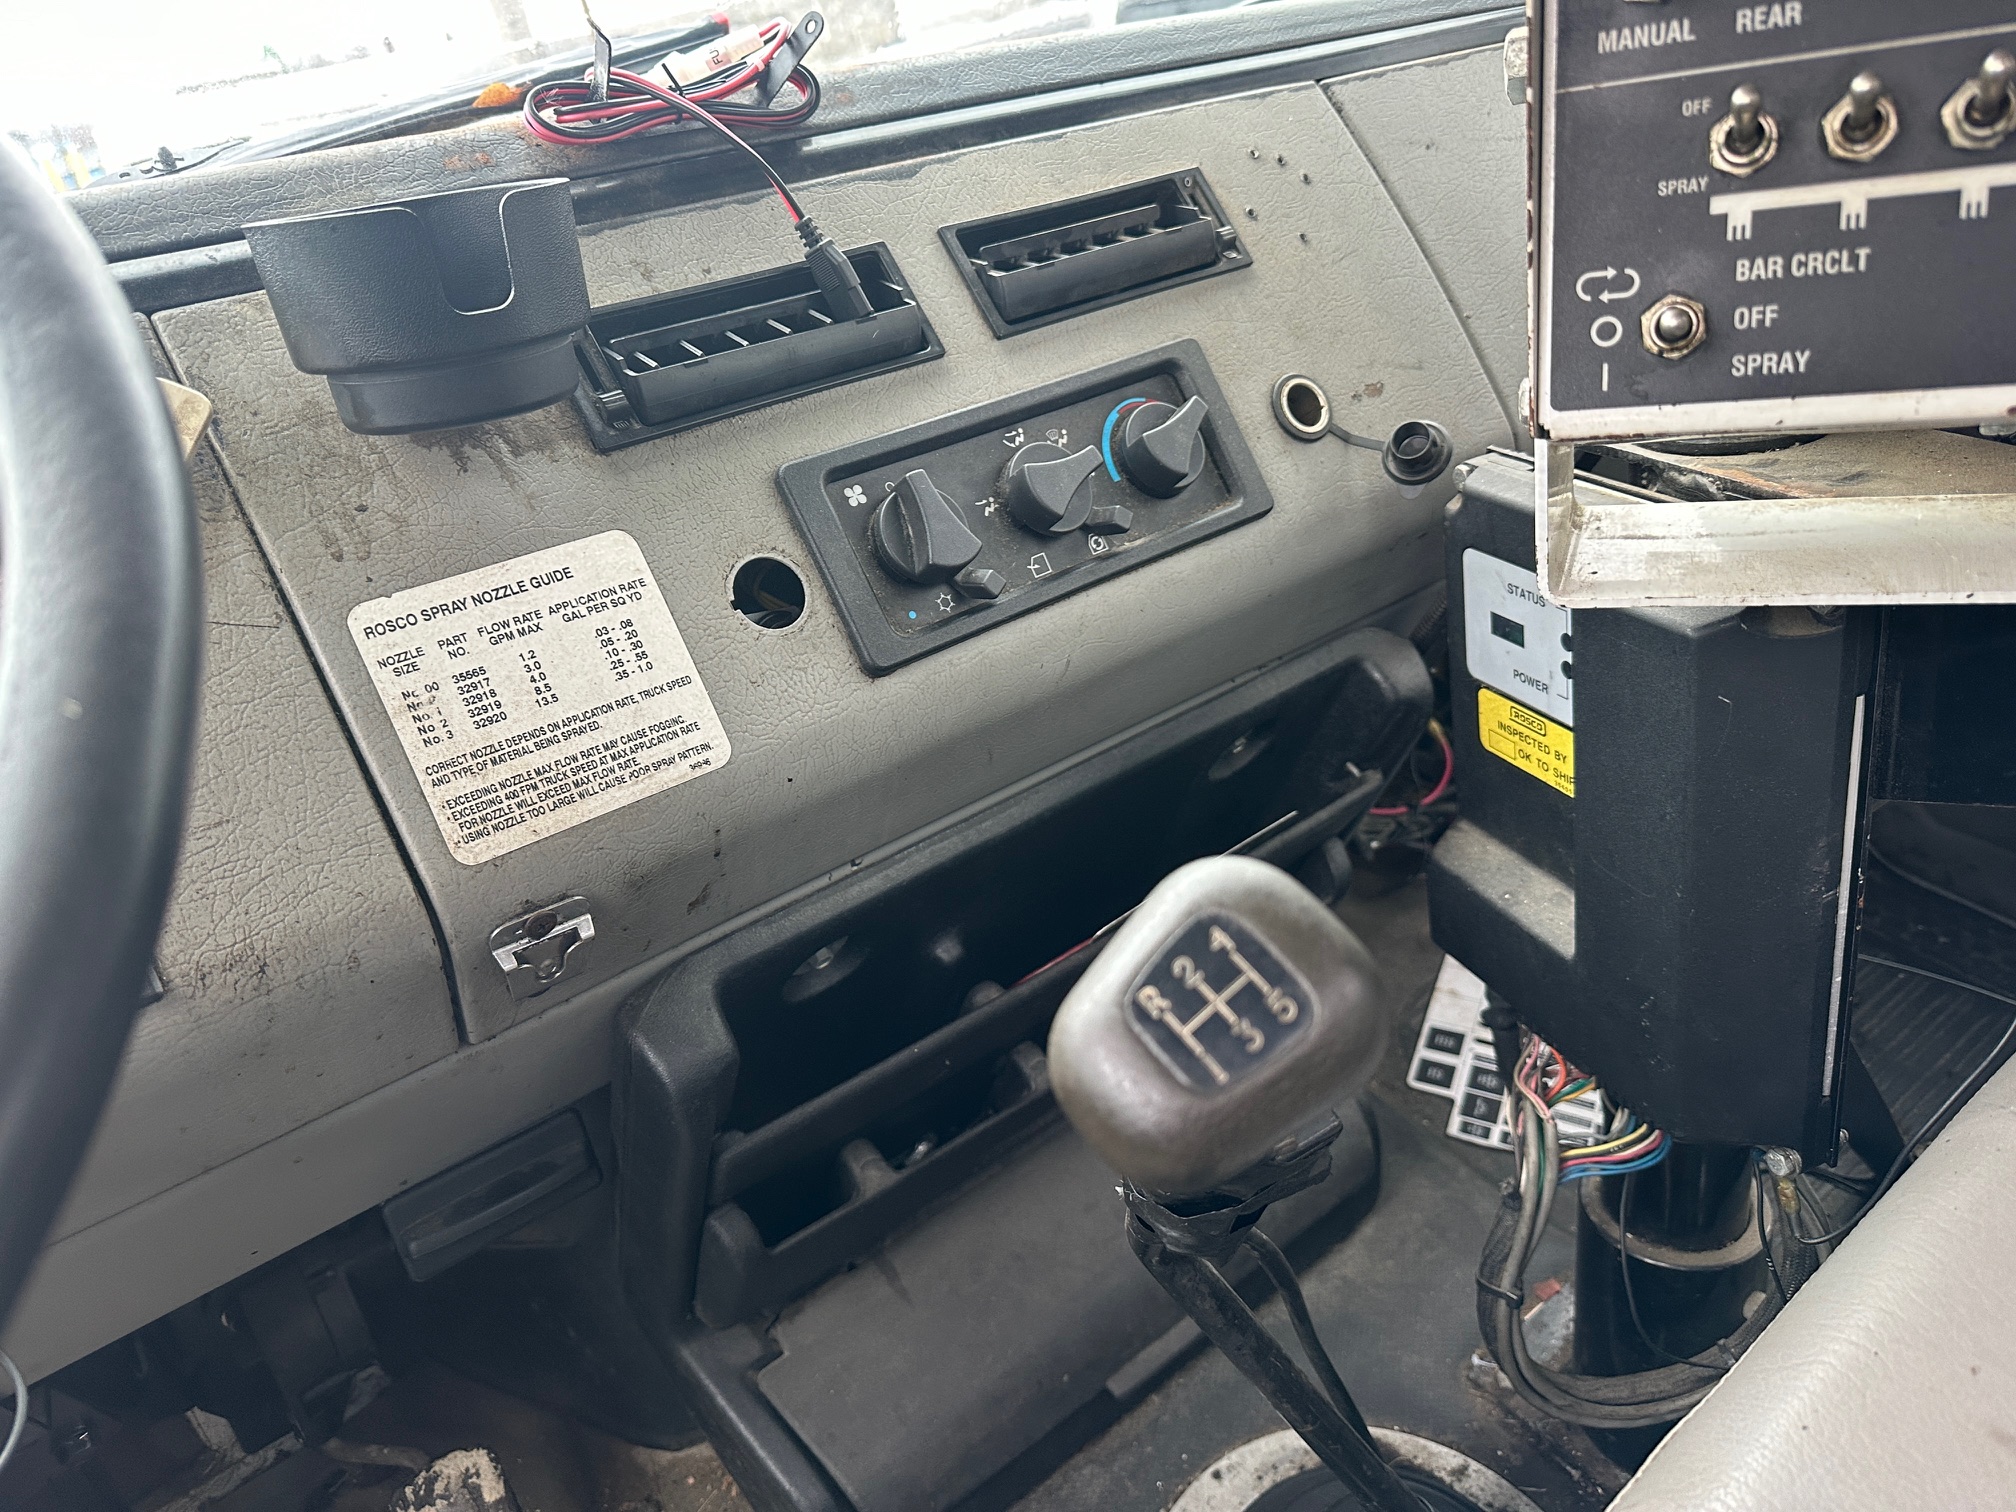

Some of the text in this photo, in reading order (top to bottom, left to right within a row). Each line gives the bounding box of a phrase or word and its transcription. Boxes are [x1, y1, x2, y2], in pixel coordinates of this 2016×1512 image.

[1598, 18, 1696, 54] MANUAL
[1736, 1, 1802, 34] REAR
[1682, 96, 1713, 116] OFF
[1658, 174, 1709, 196] SPRAY
[1736, 246, 1872, 282] BAR CRCLT
[1734, 304, 1779, 330] OFF
[1731, 348, 1811, 377] SPRAY
[363, 567, 574, 640] ROSCO SPRAY NOZZLE GUIDE
[377, 578, 647, 670] NOZZLE PART FLOW RATE APPLICATION RATE
[1507, 582, 1546, 608] STATUS
[392, 592, 642, 677] SIZE NO. GPM MAX GAL PER SQ YD
[424, 682, 440, 693] 00
[452, 666, 487, 684] 35565
[519, 650, 537, 662] 1.2
[595, 626, 610, 638] .03
[619, 619, 634, 630] .08
[457, 677, 490, 695] 32917
[524, 661, 541, 673] 3.0
[600, 637, 615, 649] .05
[625, 630, 638, 641] .20
[422, 736, 444, 748] No.
[446, 730, 454, 739] 3
[473, 711, 507, 730] 32920
[535, 694, 559, 708] 13.5
[615, 669, 630, 682] .35
[638, 662, 653, 673] 1.0
[440, 719, 449, 728] 2
[468, 700, 502, 718] 32919
[534, 683, 552, 696] 8.5
[610, 659, 625, 671] .25
[635, 651, 648, 663] .55
[462, 689, 497, 707] 32918
[530, 672, 547, 684] 4.0
[605, 648, 619, 660] .10
[630, 640, 643, 652] .30
[1513, 669, 1549, 694] POWER
[426, 676, 692, 776] CORRECT NOZZLE DEPENDS ON APPLICATION RATE, TRUCK SPEED
[1498, 720, 1567, 763] INSPECTED BY
[1514, 710, 1542, 731] ROSCO
[432, 721, 603, 788] AND TYPE OF MATERIAL BEING SPRAYED.
[446, 715, 685, 810] EXCEEDING NOZZLE MAX FLOW RATE MAY CAUSE FOGGING.
[451, 722, 701, 822] EXCEEDING 400 FPM TRUCK SPEED AT MAX APPLICATION RATE
[1518, 748, 1532, 763] OK
[1536, 758, 1549, 772] TO
[458, 757, 641, 832] FOR NOZZLE WILL EXCEED MAX FLOW RATE.
[461, 827, 491, 844] USING
[491, 813, 527, 834] NOZZLE
[526, 806, 546, 819] TOO
[546, 793, 578, 812] LARGE
[576, 786, 599, 800] WILL
[598, 774, 628, 792] CAUSE
[629, 765, 651, 781] POOR
[651, 755, 676, 771] SPRAY
[677, 742, 714, 762] PATTERN.
[1136, 924, 1236, 1020] R 2 4
[1231, 1017, 1265, 1054] 3
[1264, 986, 1298, 1025] 5
